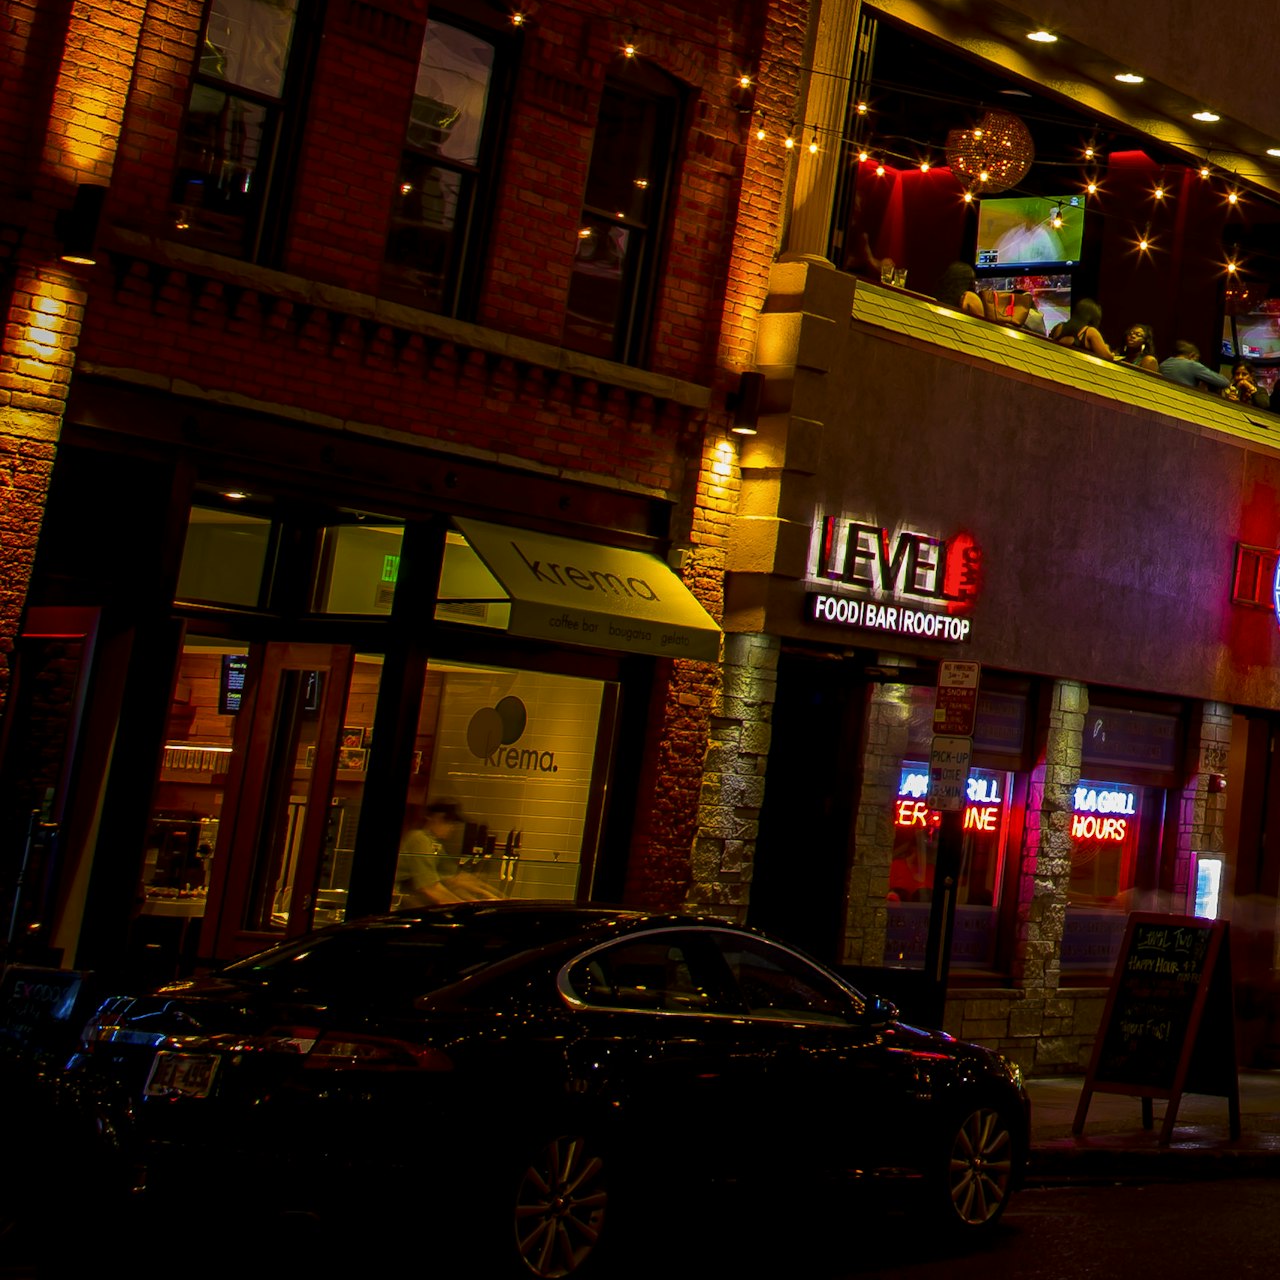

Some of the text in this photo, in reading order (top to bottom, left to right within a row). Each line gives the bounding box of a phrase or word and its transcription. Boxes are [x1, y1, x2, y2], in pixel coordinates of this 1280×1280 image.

[510, 540, 661, 602] krema
[816, 515, 965, 603] LEVEL
[550, 613, 690, 647] coffee bar bougatsa gelato
[946, 687, 968, 697] SNOW
[932, 750, 969, 764] PICK-UP
[1071, 815, 1127, 841] HOURS
